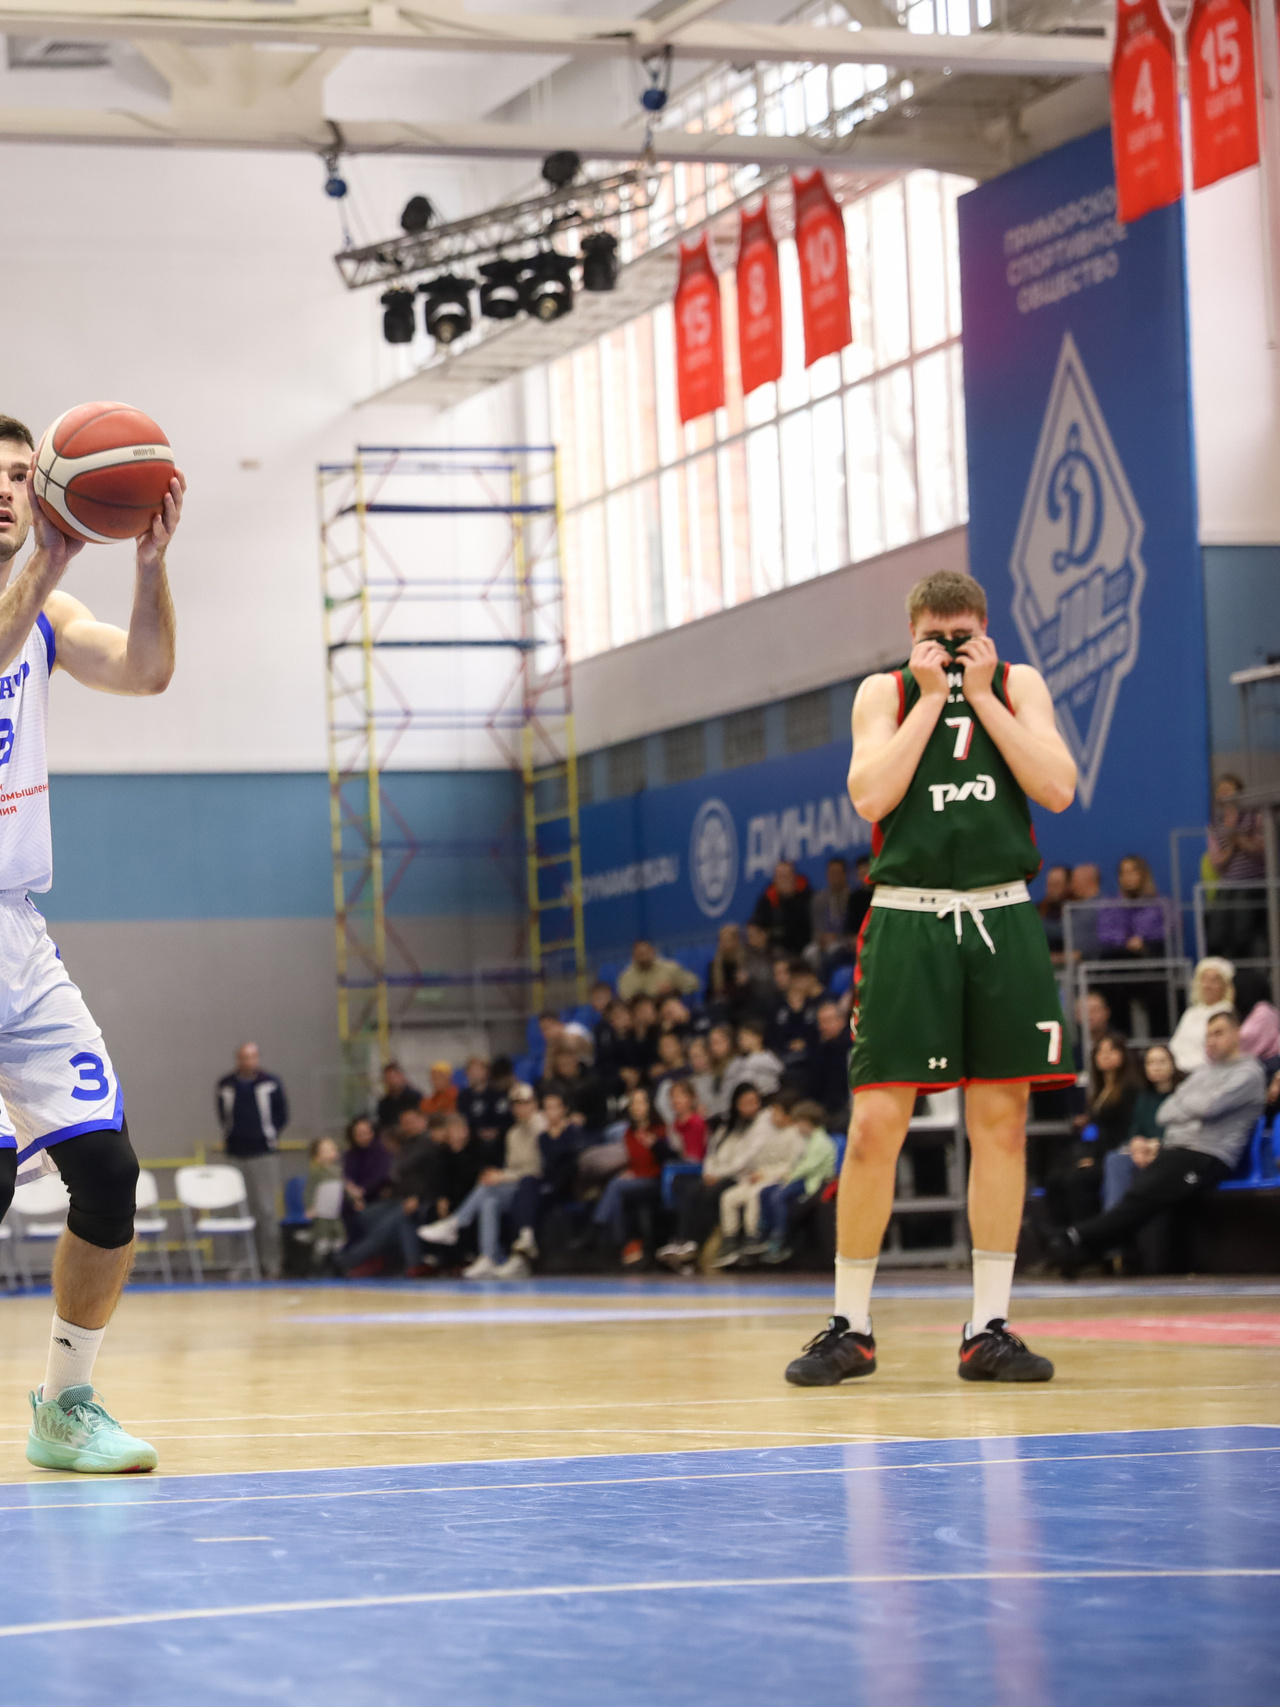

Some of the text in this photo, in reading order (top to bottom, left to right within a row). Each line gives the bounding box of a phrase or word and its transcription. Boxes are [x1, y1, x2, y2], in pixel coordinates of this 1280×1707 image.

[1201, 18, 1240, 91] 15
[1131, 58, 1155, 120] 4
[1004, 186, 1117, 256] ПРИМОРСКО
[944, 716, 975, 761] 7
[1035, 1021, 1063, 1065] 7
[69, 1051, 110, 1101] 3
